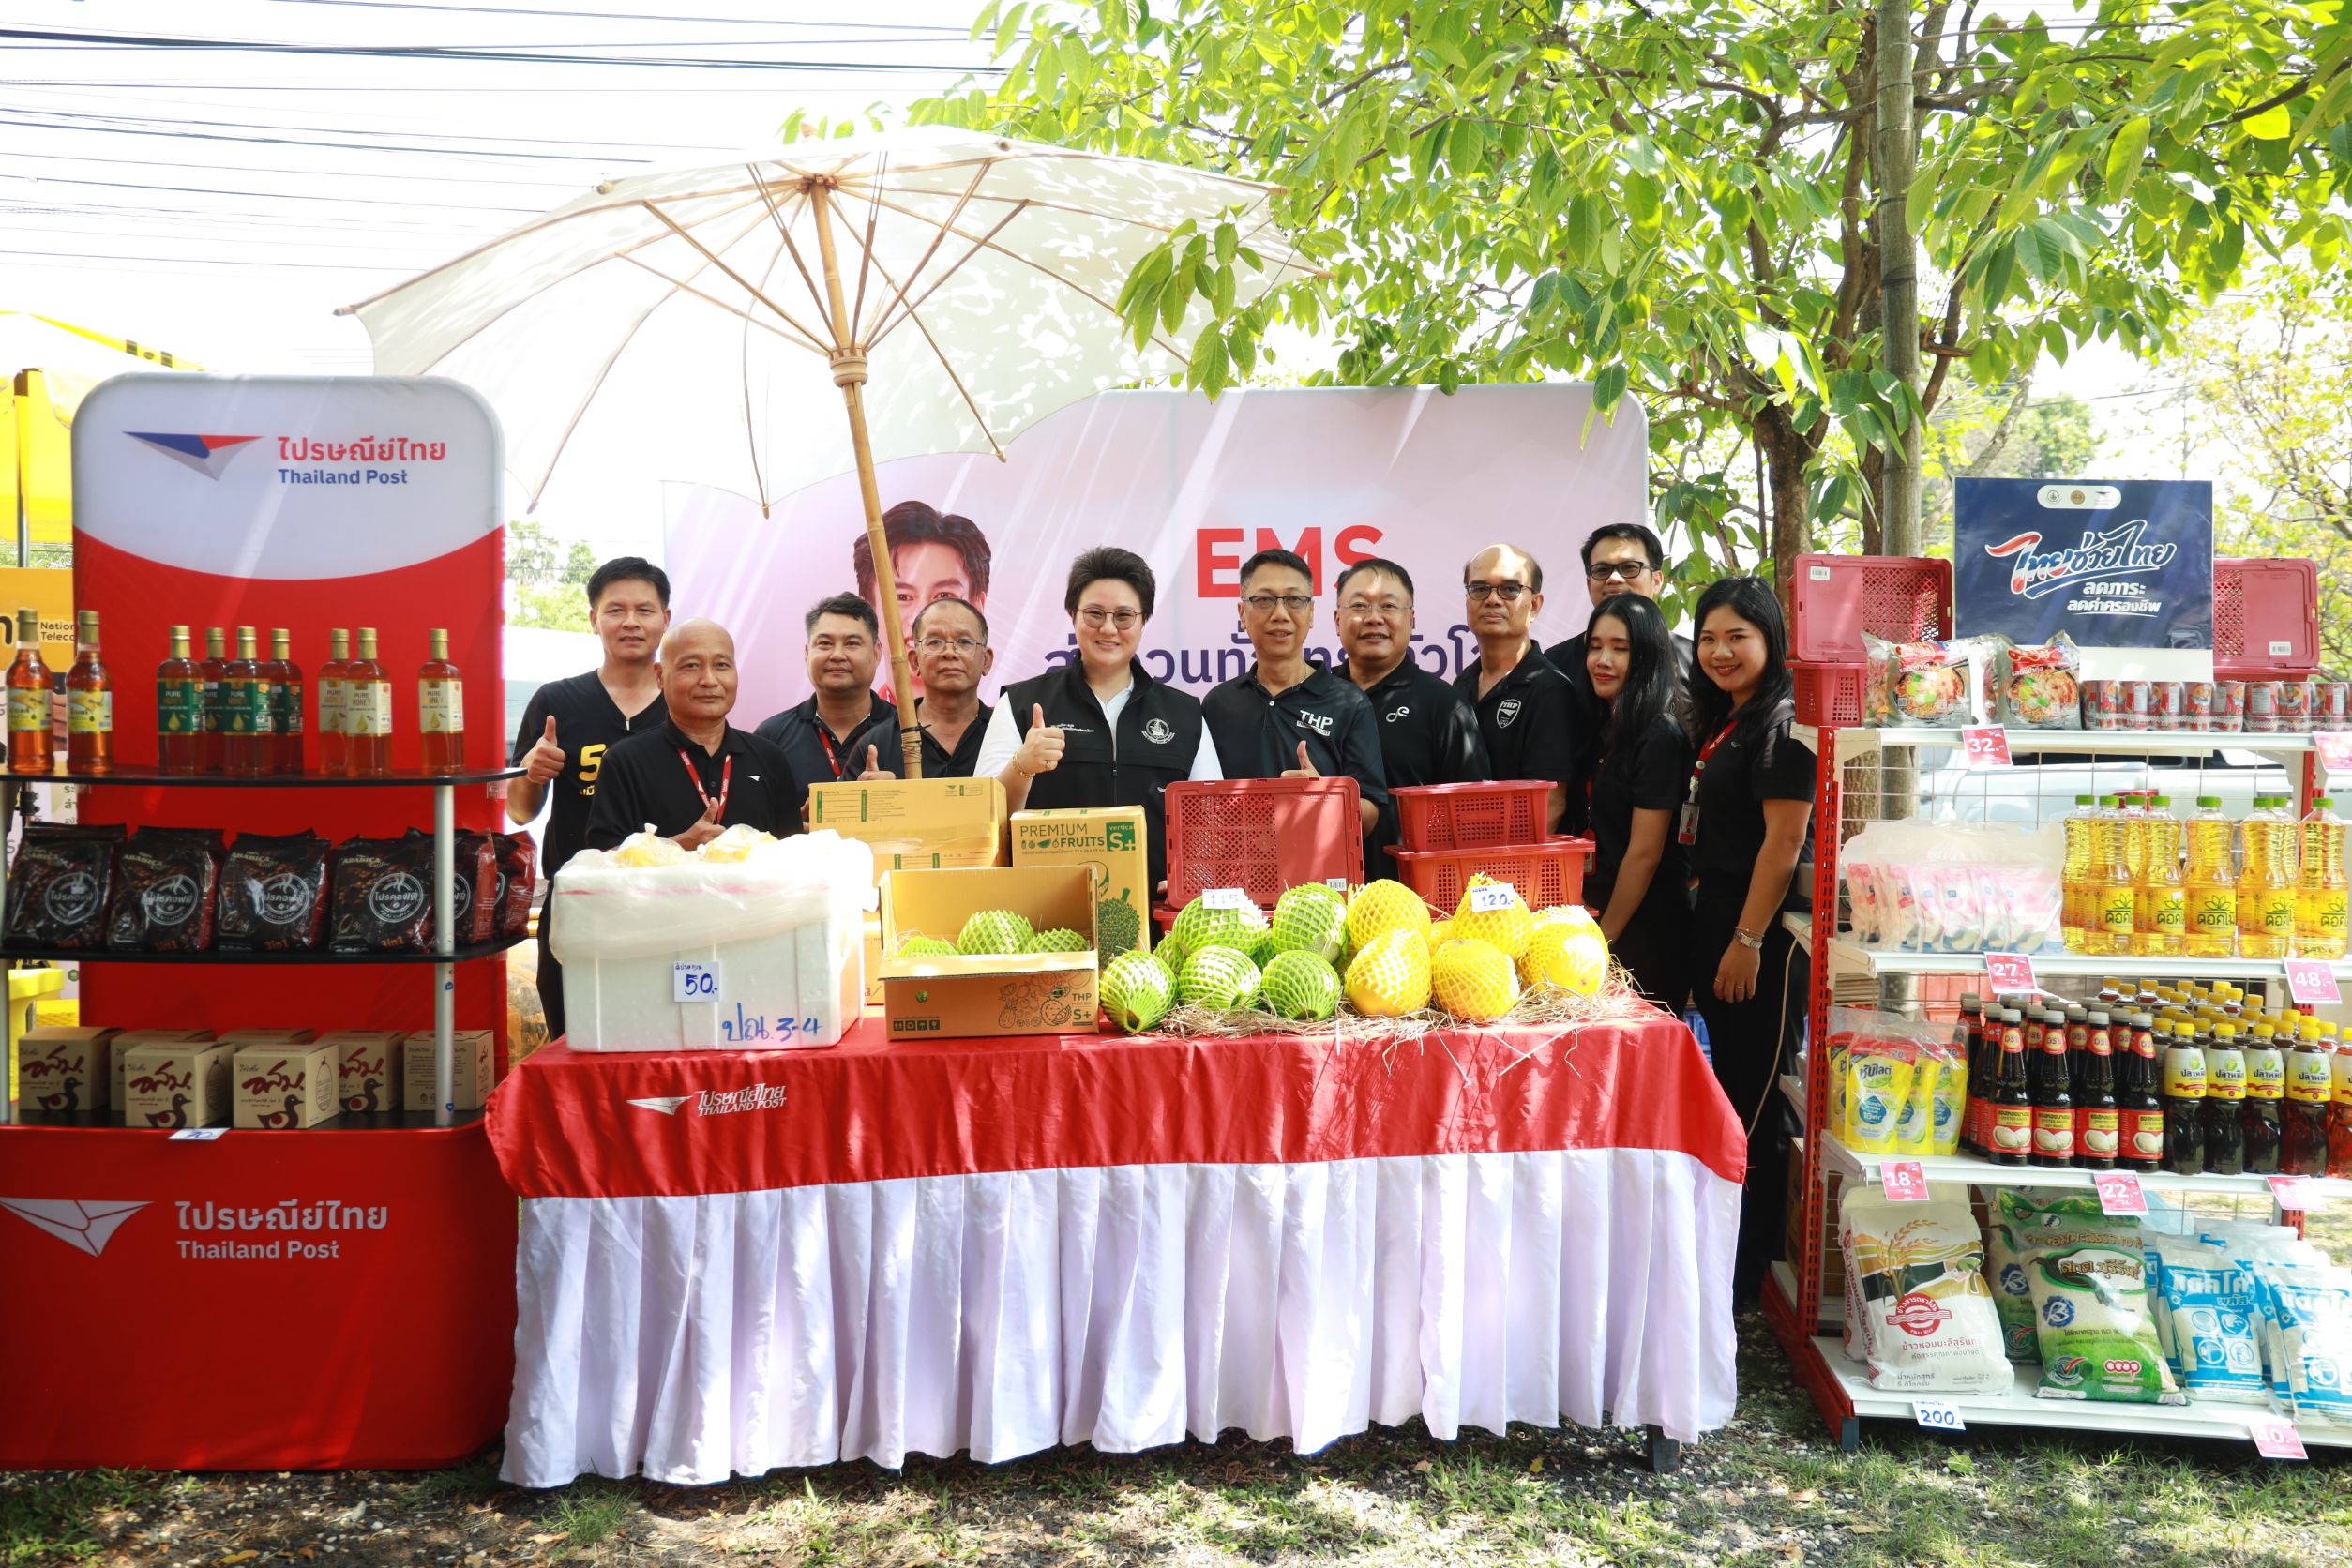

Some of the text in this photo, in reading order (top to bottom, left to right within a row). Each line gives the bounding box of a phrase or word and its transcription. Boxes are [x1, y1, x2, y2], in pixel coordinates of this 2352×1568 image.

[278, 436, 445, 461] ไปรษณีย์ไทย
[279, 469, 408, 484] Thailand Post
[1197, 525, 1383, 598] EMS
[1985, 520, 2177, 594] ไทยช่วยไทย
[2083, 581, 2146, 596] ลดภาระ
[2067, 598, 2162, 612] ลดค่าครองชีพ
[1300, 709, 1334, 729] THP
[1968, 737, 2005, 753] 32.-
[1020, 823, 1088, 837] PREMIUM
[1060, 837, 1105, 848] FRUITS
[1109, 832, 1136, 852] S+
[342, 856, 381, 865] ARABICA
[2265, 912, 2289, 927] ดอก
[2320, 913, 2348, 927] ดอกไ
[1992, 962, 2029, 977] 27.-
[2295, 972, 2331, 987] 48.-
[1072, 992, 1092, 1002] THP
[1073, 1008, 1092, 1020] S+
[698, 1097, 787, 1117] THAILAND POST
[1886, 1171, 1922, 1187] 18.-
[2101, 1183, 2139, 1199] 22.-
[175, 1199, 387, 1230] ไปรษณีย์ไทย
[176, 1240, 339, 1259] Thailand Post
